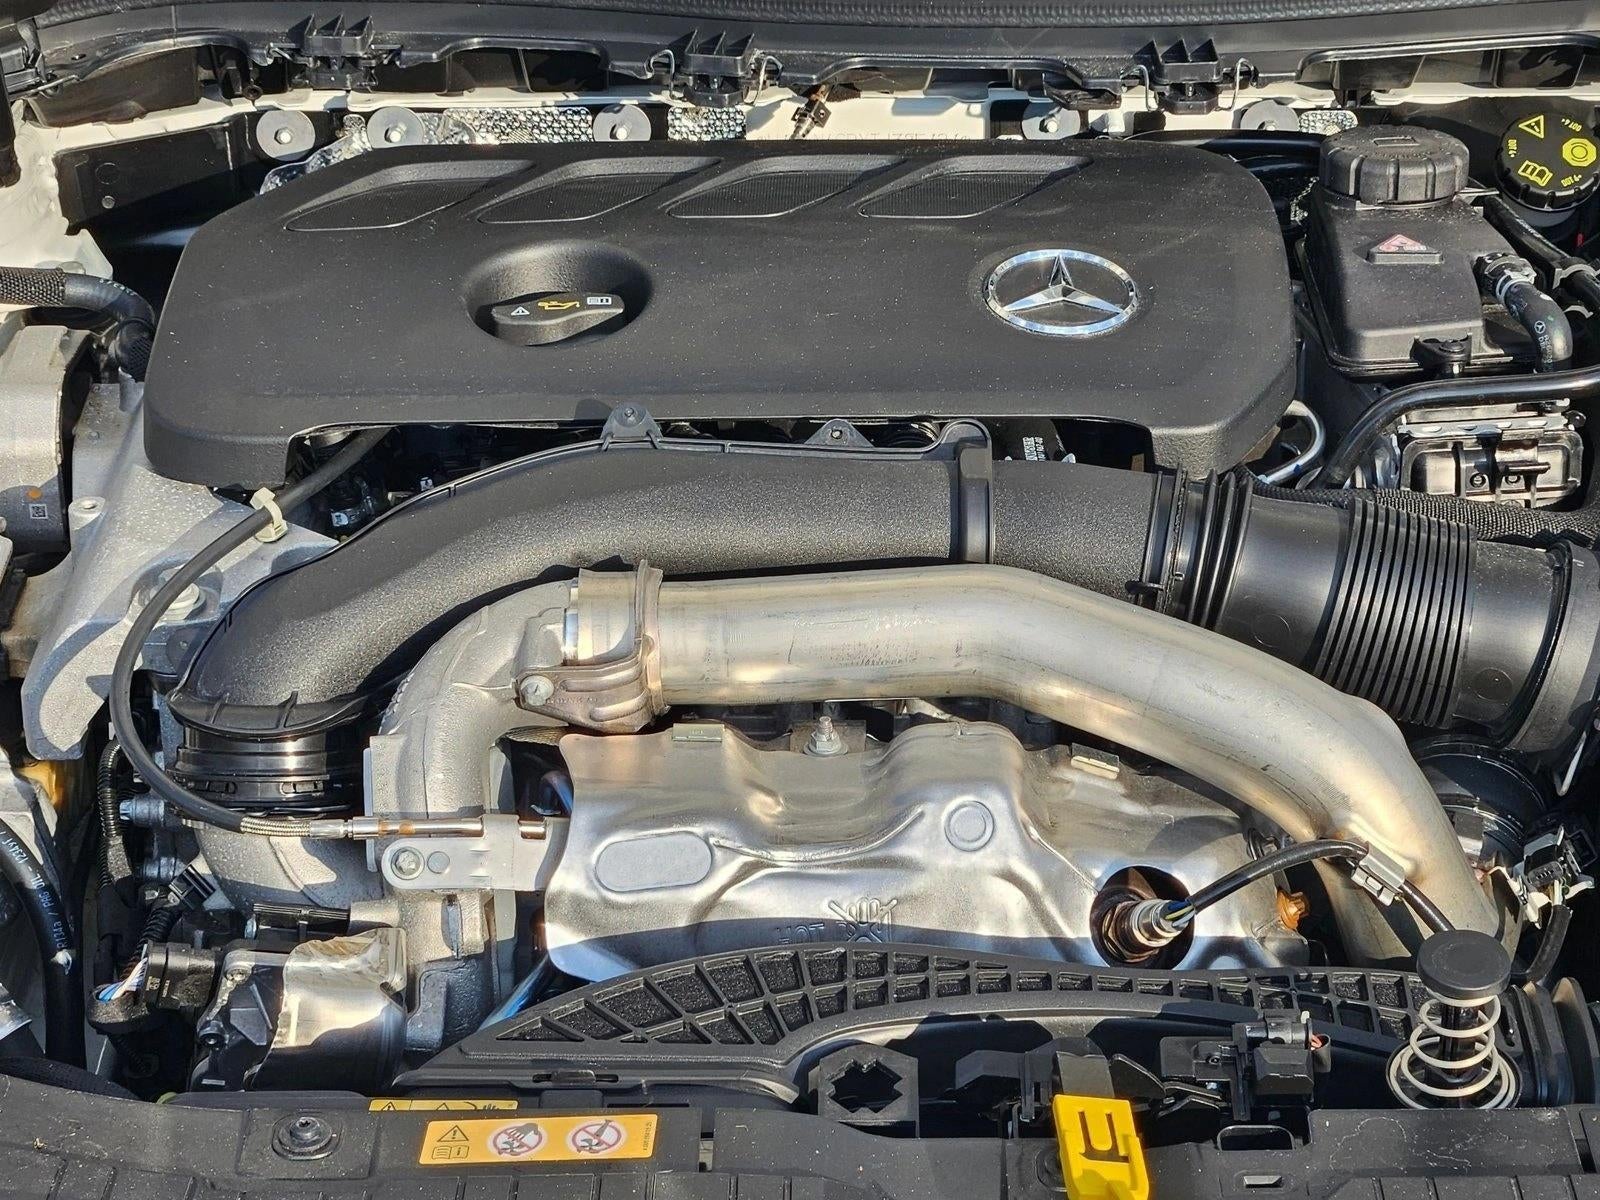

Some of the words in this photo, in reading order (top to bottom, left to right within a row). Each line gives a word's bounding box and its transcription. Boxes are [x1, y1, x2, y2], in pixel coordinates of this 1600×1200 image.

[1, 838, 28, 864] 1234yf
[31, 873, 45, 890] OIL
[38, 891, 54, 909] PAG
